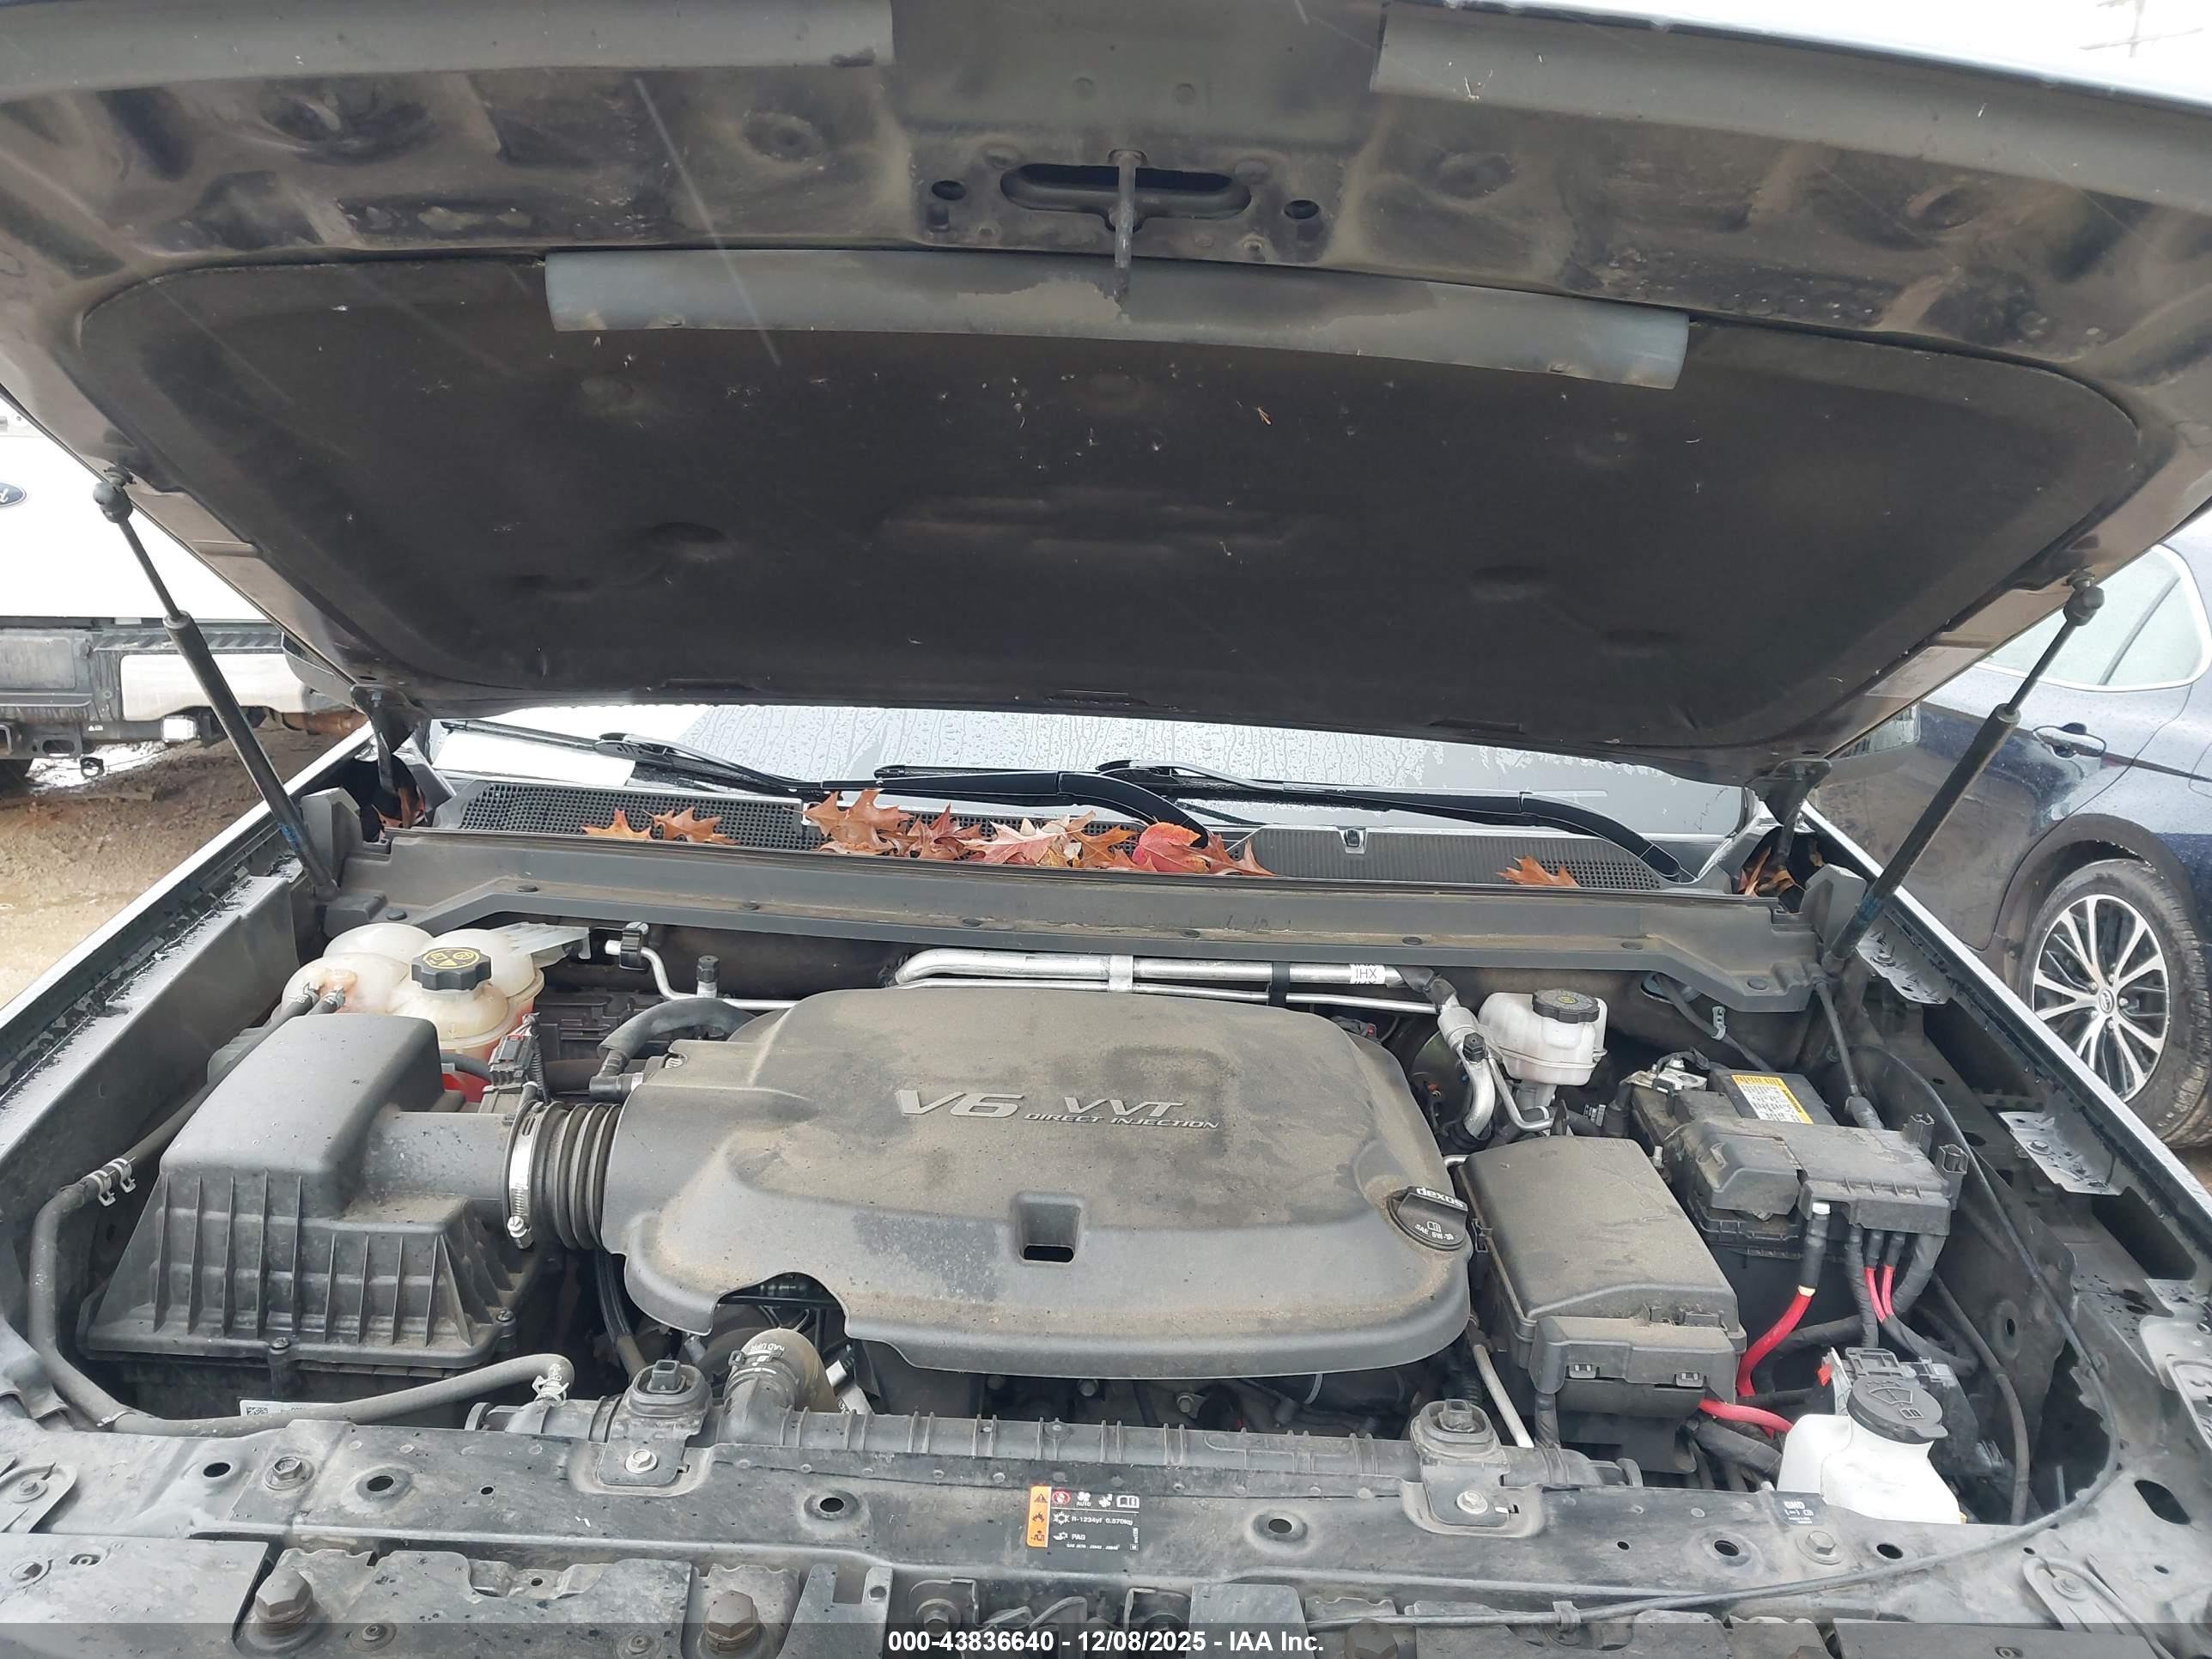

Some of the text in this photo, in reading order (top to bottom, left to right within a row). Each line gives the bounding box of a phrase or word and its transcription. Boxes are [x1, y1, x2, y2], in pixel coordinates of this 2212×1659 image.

[1357, 968, 1376, 979] IHX
[894, 1089, 1024, 1117] V6
[1064, 1097, 1184, 1117] VVT
[1024, 1113, 1220, 1129] DIRECT INJECTION
[1416, 1188, 1463, 1208] dexos
[1415, 1224, 1429, 1235] SAE
